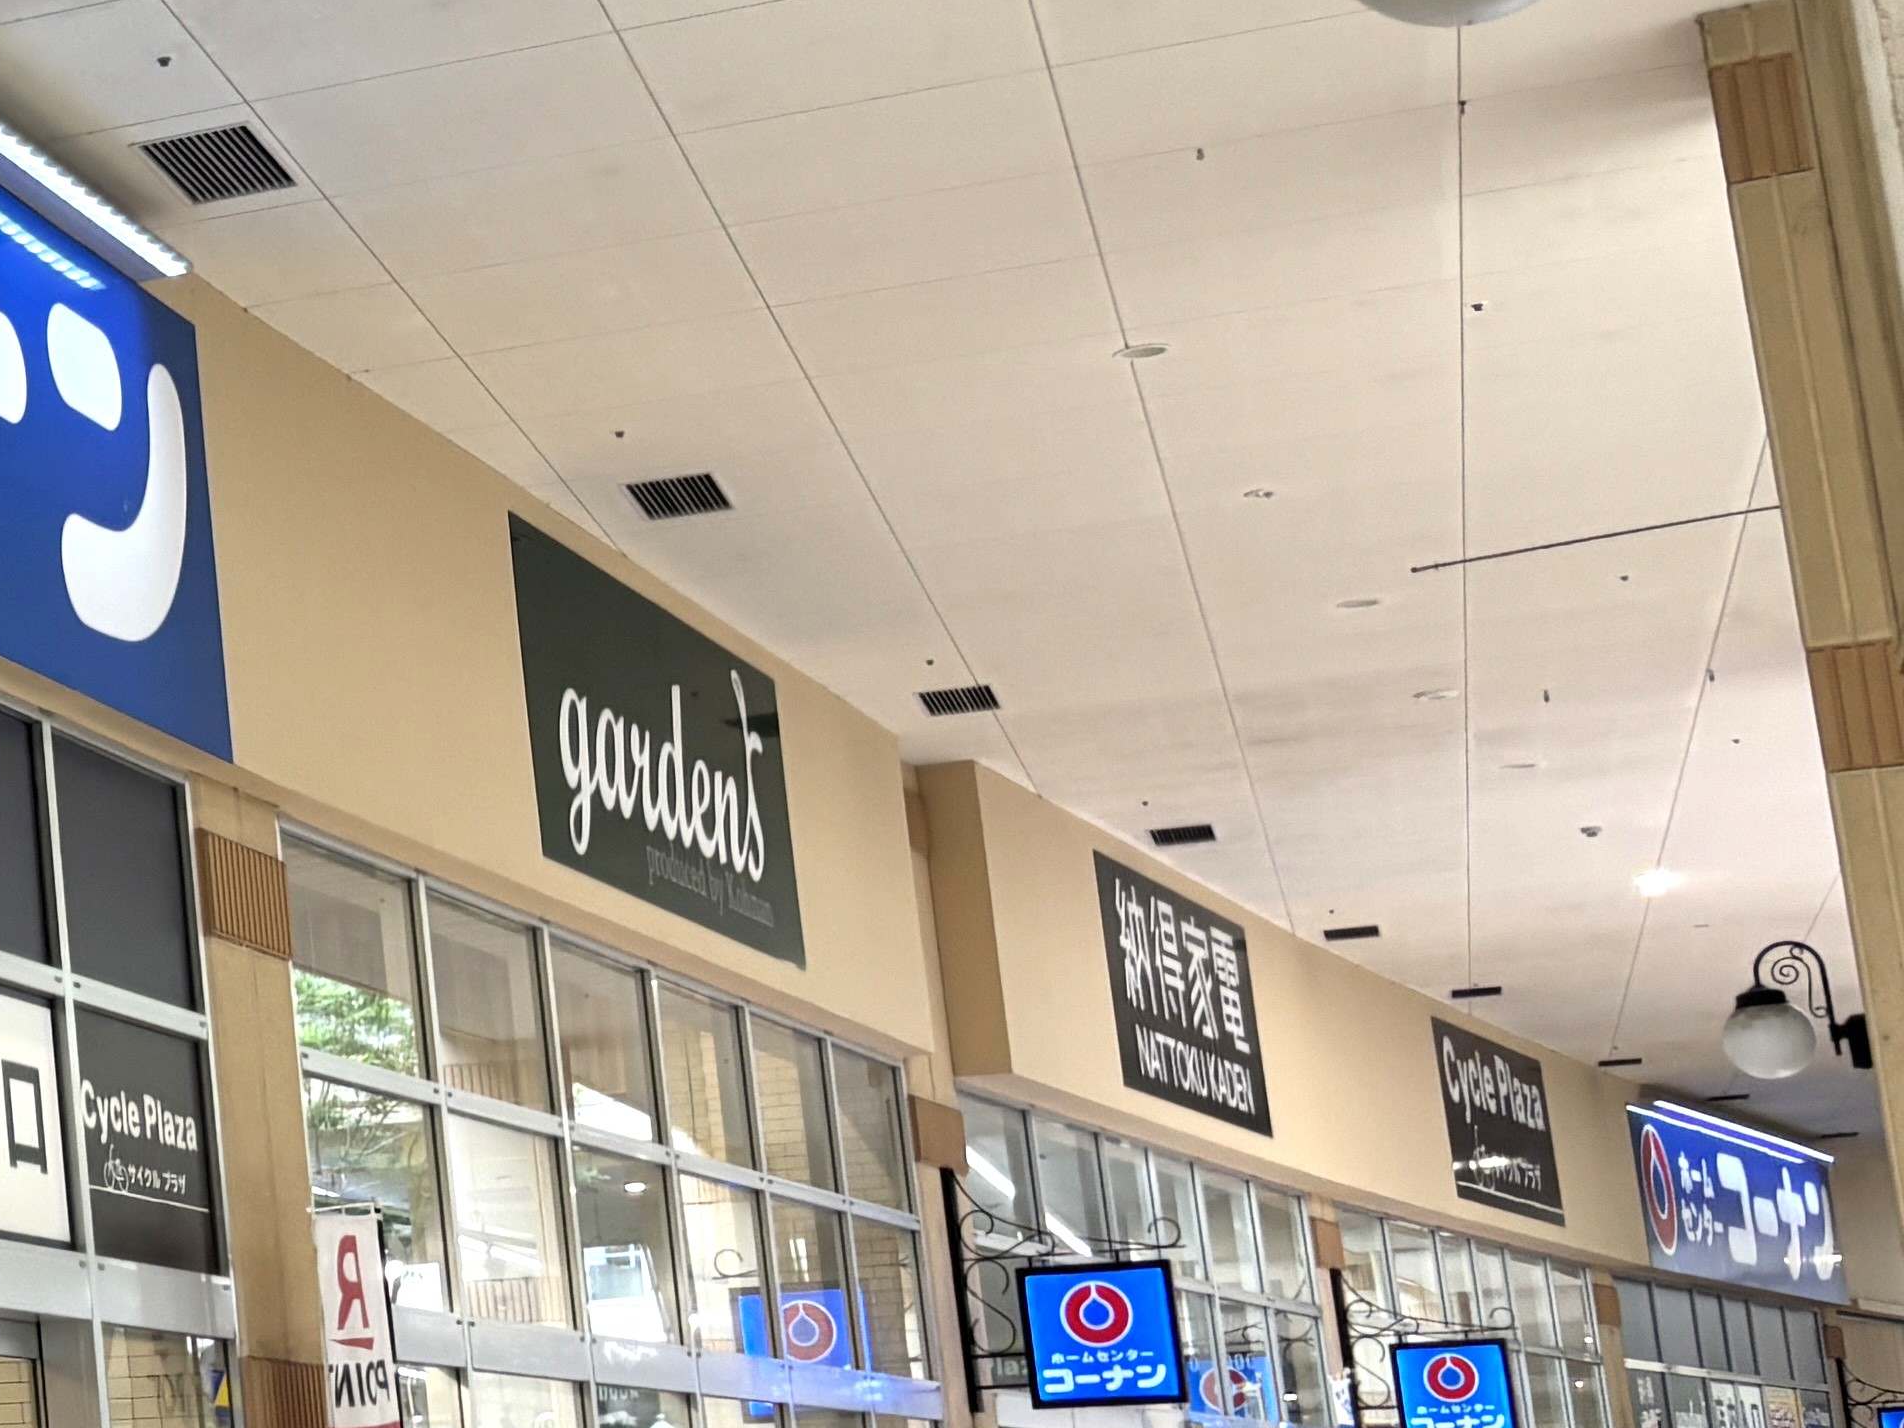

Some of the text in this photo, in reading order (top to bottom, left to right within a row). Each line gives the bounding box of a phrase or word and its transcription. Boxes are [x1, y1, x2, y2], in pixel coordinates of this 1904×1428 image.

[1115, 877, 1251, 1053] 納得家電
[1135, 1024, 1254, 1115] NATTOKU KADEN
[1443, 1036, 1545, 1131] Cycle Plaza
[81, 1080, 198, 1151] Cycle Plaza
[1716, 1153, 1841, 1281] コーナン
[1042, 1363, 1166, 1394] コーナン
[1051, 1350, 1154, 1364] ホームセンター
